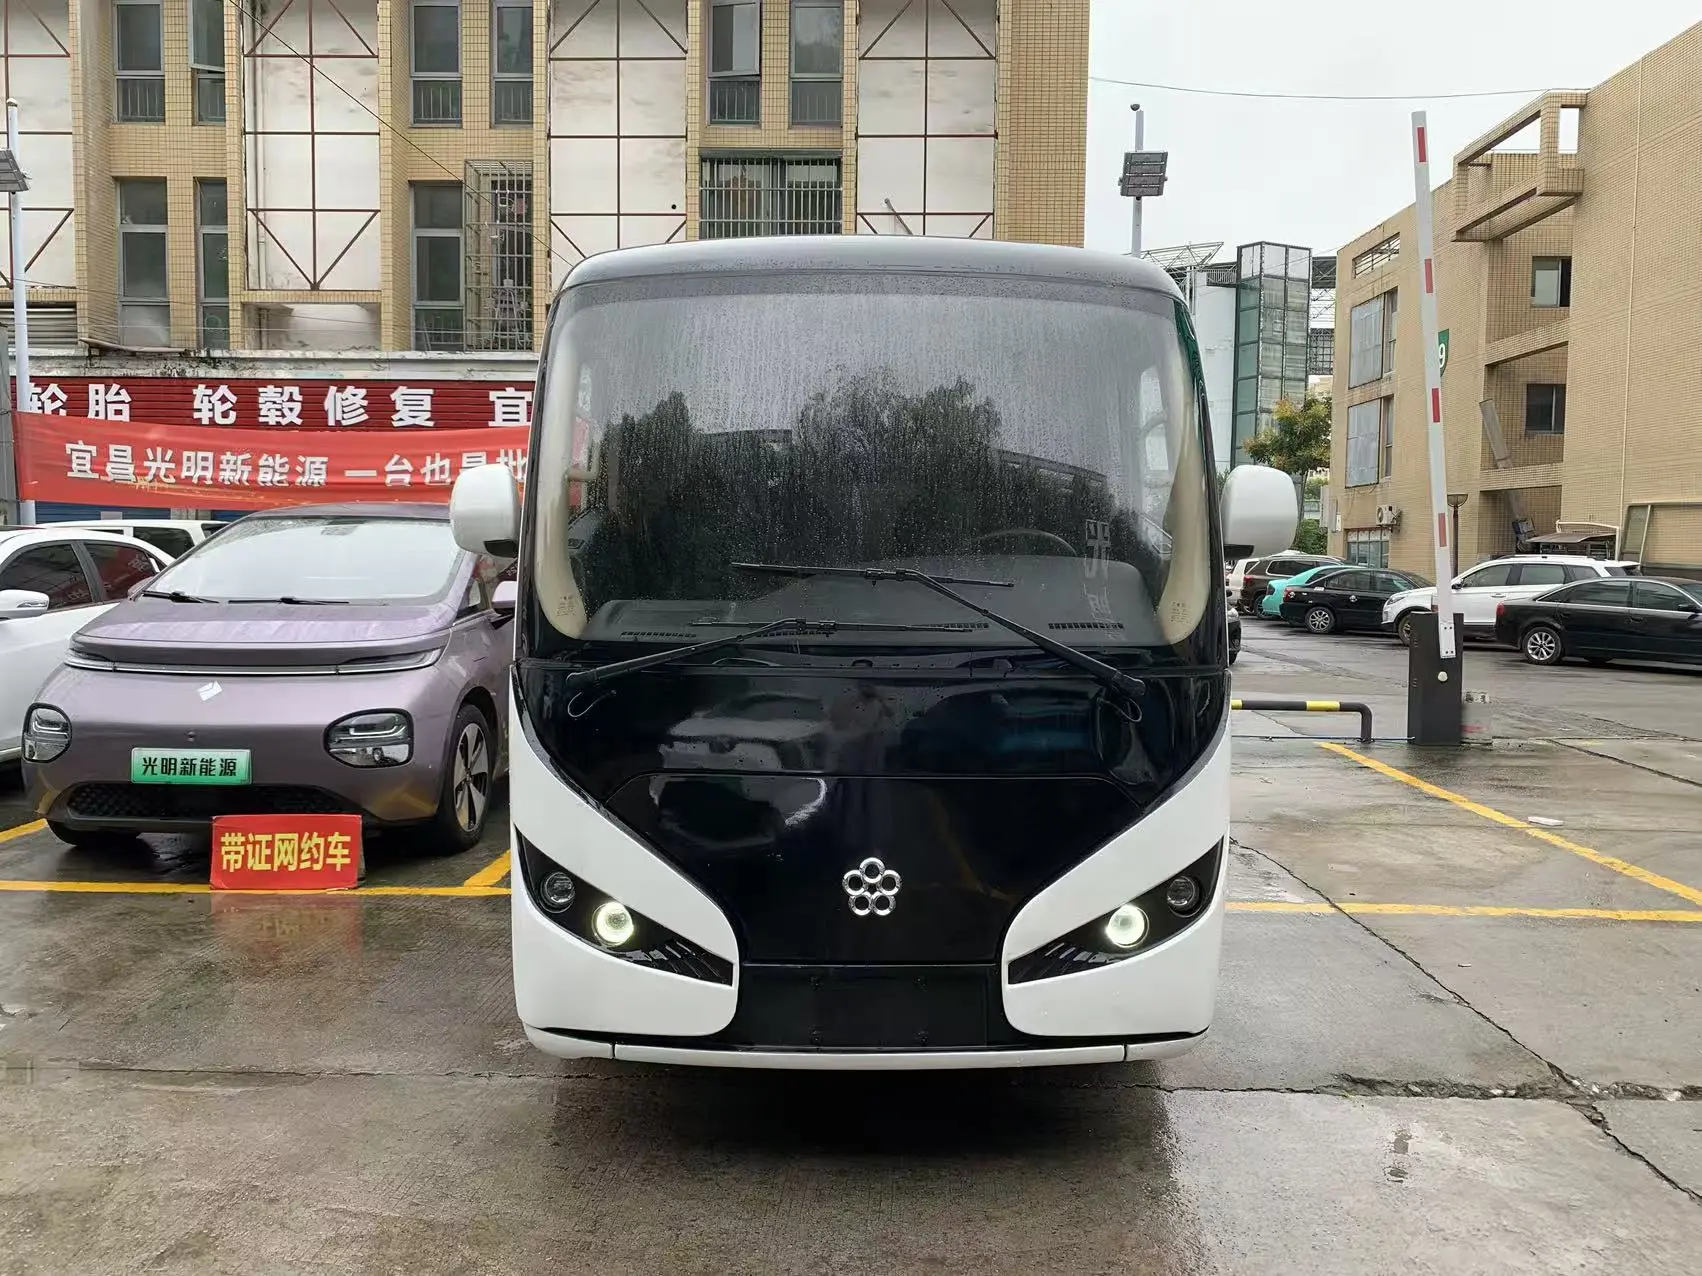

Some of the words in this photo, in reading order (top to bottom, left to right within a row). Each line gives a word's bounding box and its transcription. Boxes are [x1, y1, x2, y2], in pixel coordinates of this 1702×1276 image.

[29, 382, 132, 422] 轮胎
[192, 384, 435, 428] 轮毂修复
[488, 387, 532, 427] 宜
[65, 440, 329, 487] 宜昌光明新能源
[142, 757, 237, 776] 光明新能源
[220, 831, 352, 872] 带证网约车
